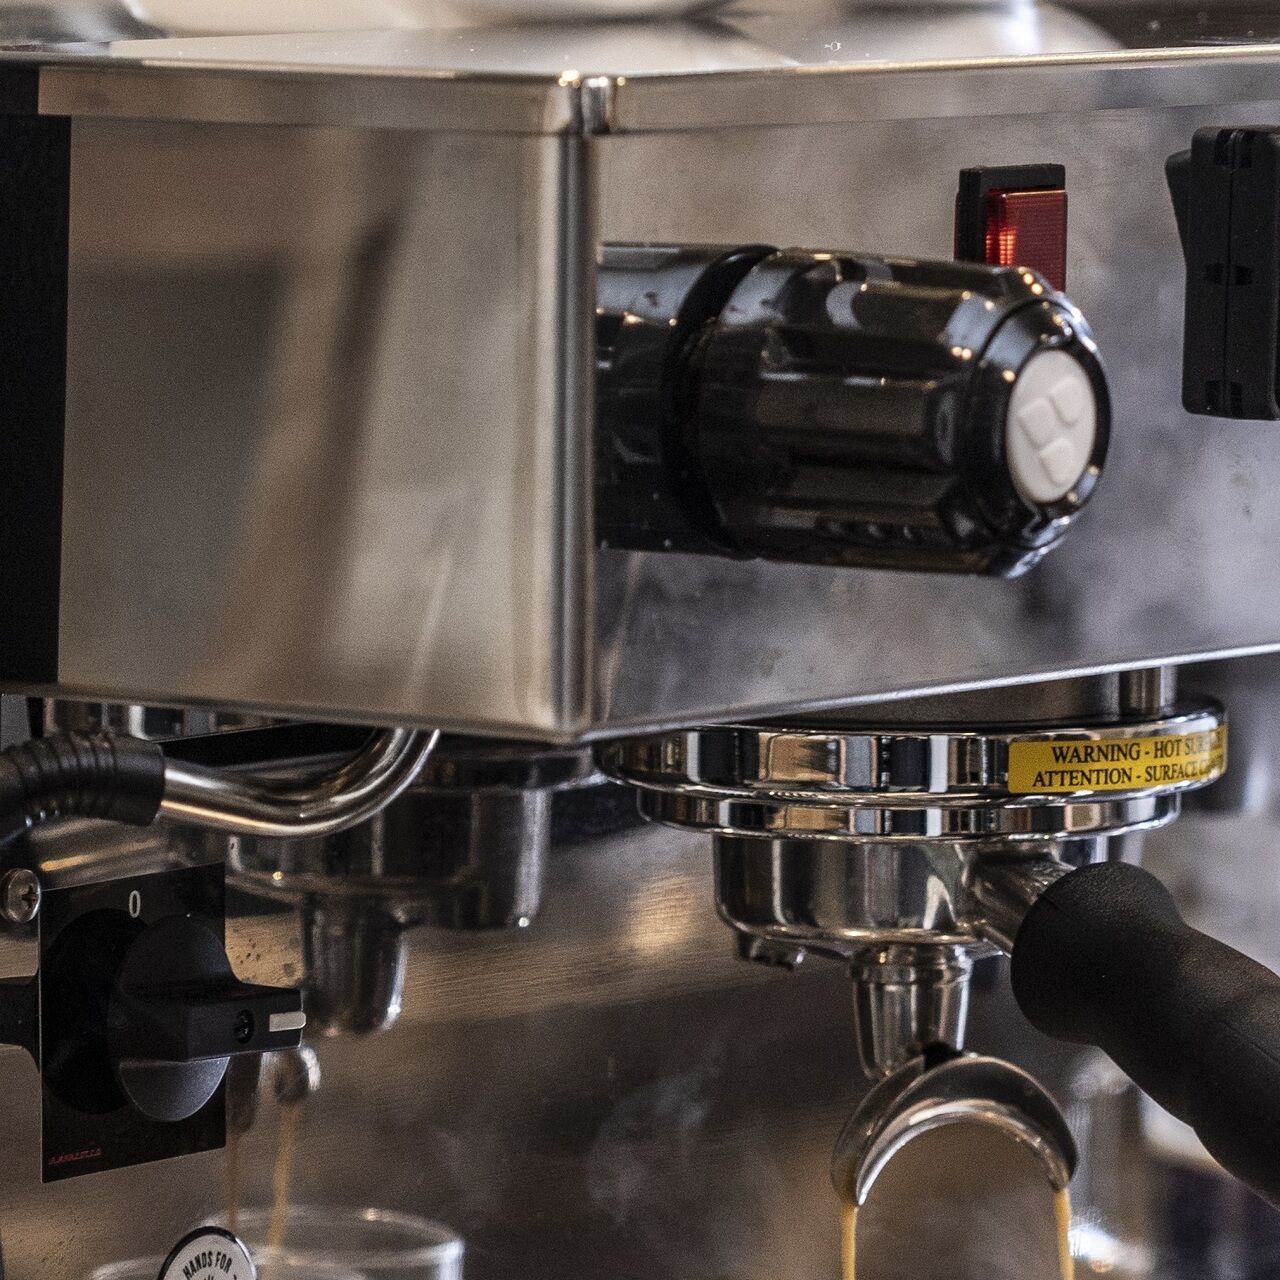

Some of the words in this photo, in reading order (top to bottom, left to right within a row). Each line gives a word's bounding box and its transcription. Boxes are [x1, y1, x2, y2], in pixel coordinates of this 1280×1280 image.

[1052, 742, 1140, 764] WARNING
[1153, 739, 1182, 759] HOT
[1032, 767, 1132, 787] ATTENTION
[1145, 760, 1197, 782] SURFACE
[182, 1250, 213, 1280] HANDS
[215, 1251, 233, 1274] FOR
